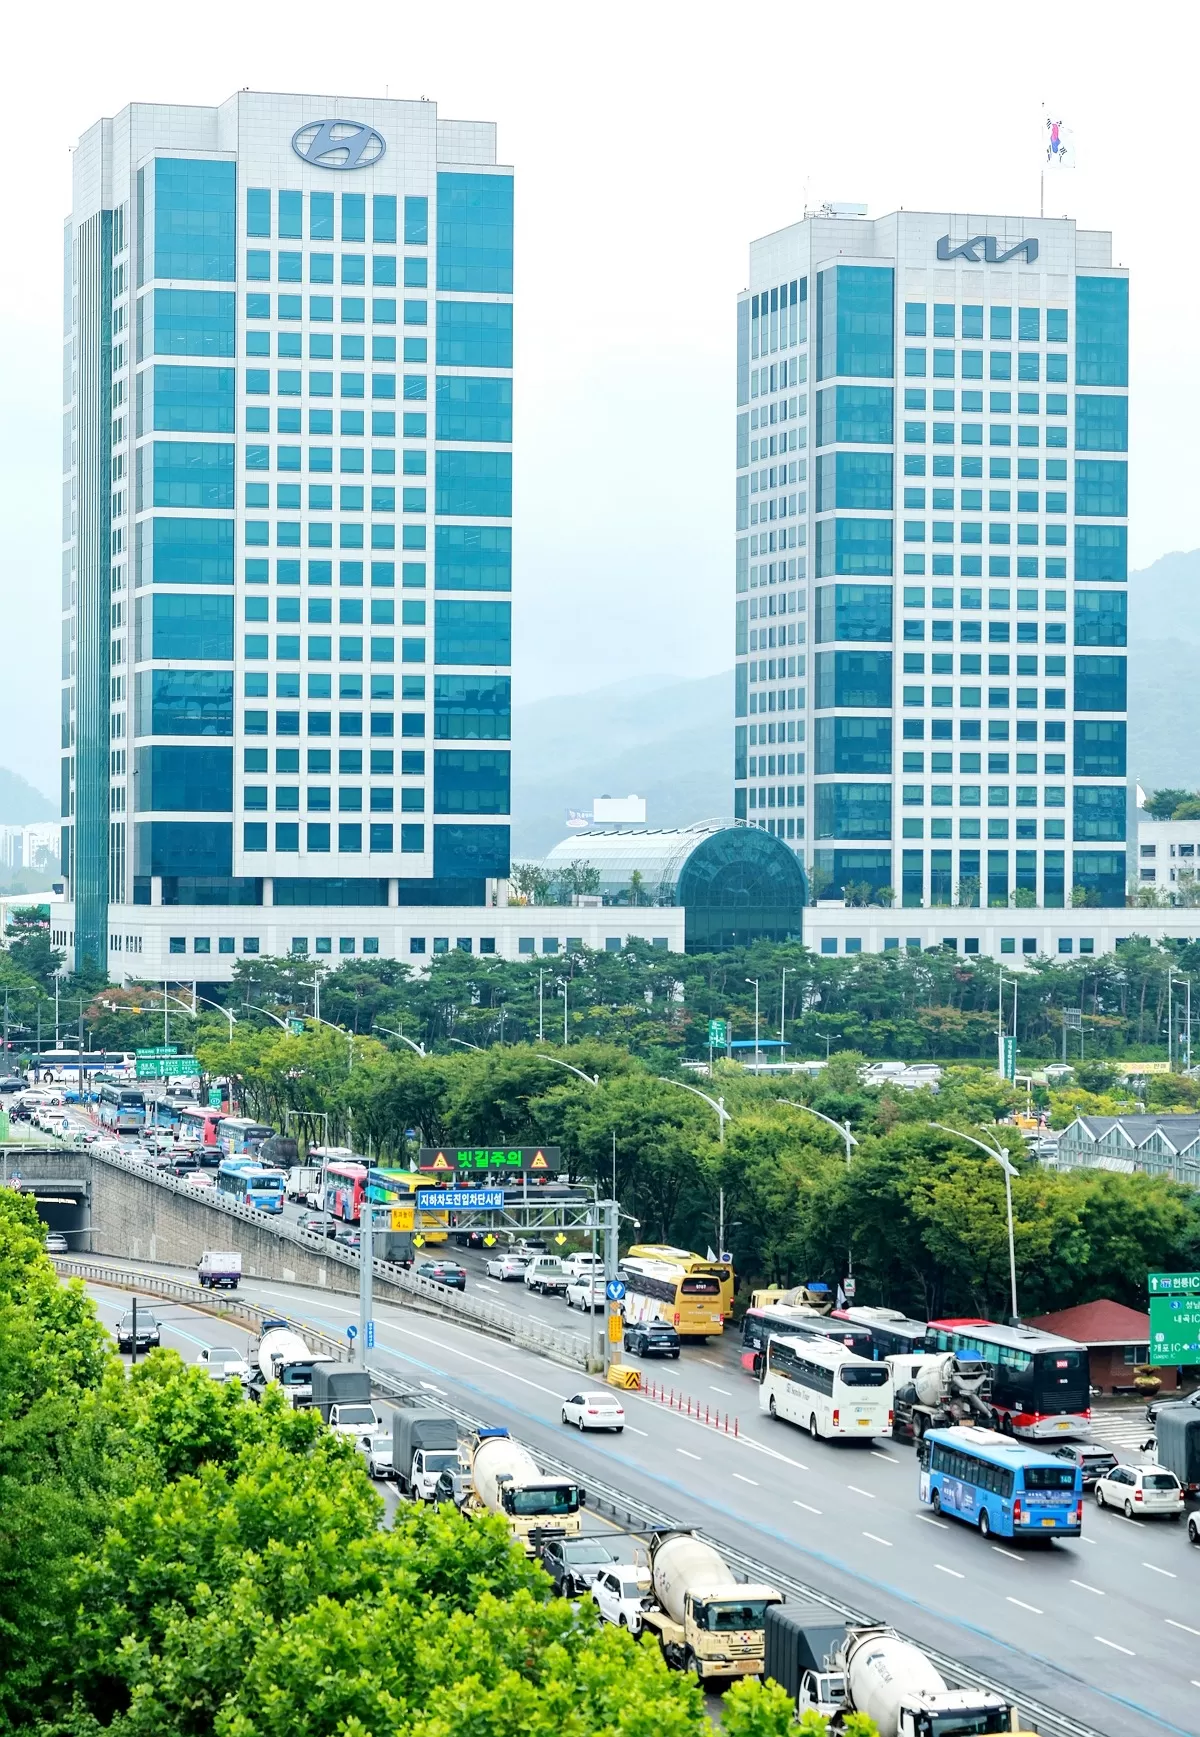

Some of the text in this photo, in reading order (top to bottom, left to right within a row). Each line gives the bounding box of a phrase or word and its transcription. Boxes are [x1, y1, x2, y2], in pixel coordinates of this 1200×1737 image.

[937, 233, 1039, 264] KIA
[457, 1150, 522, 1168] 빗길주의
[420, 1192, 503, 1206] 지하차도진입차단시설
[1060, 1475, 1072, 1484] 140
